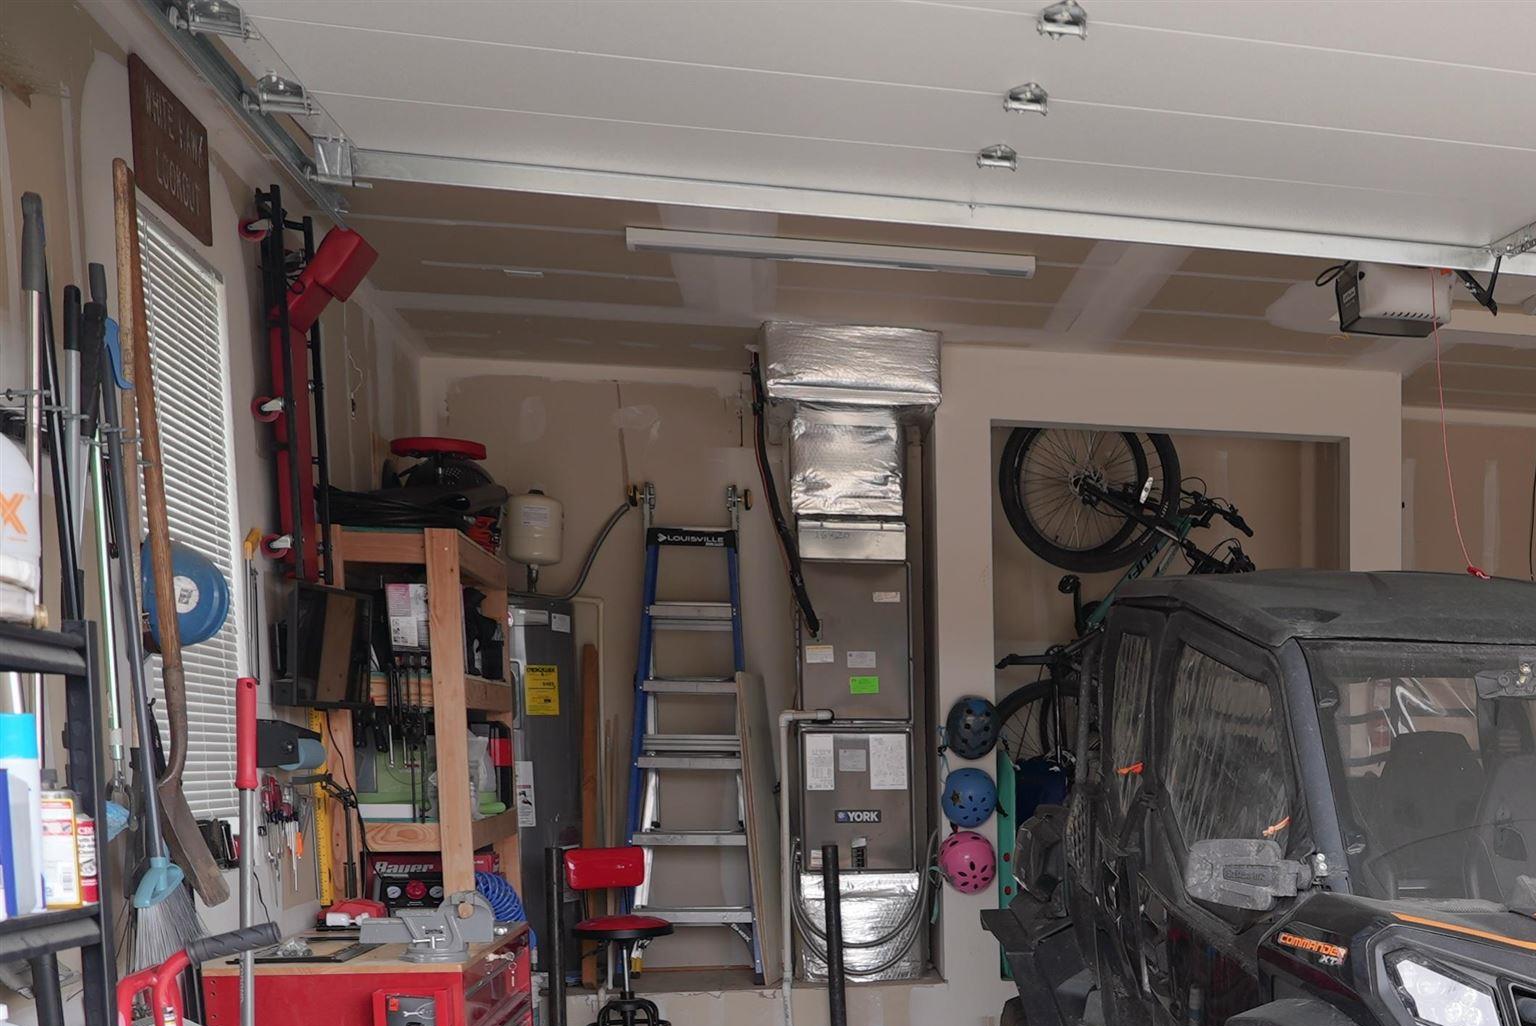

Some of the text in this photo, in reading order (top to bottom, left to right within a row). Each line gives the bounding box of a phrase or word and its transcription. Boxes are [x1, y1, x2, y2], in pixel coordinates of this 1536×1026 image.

[667, 535, 724, 543] LOUISVILLE
[848, 811, 879, 822] YORK
[374, 861, 434, 873] Bauer
